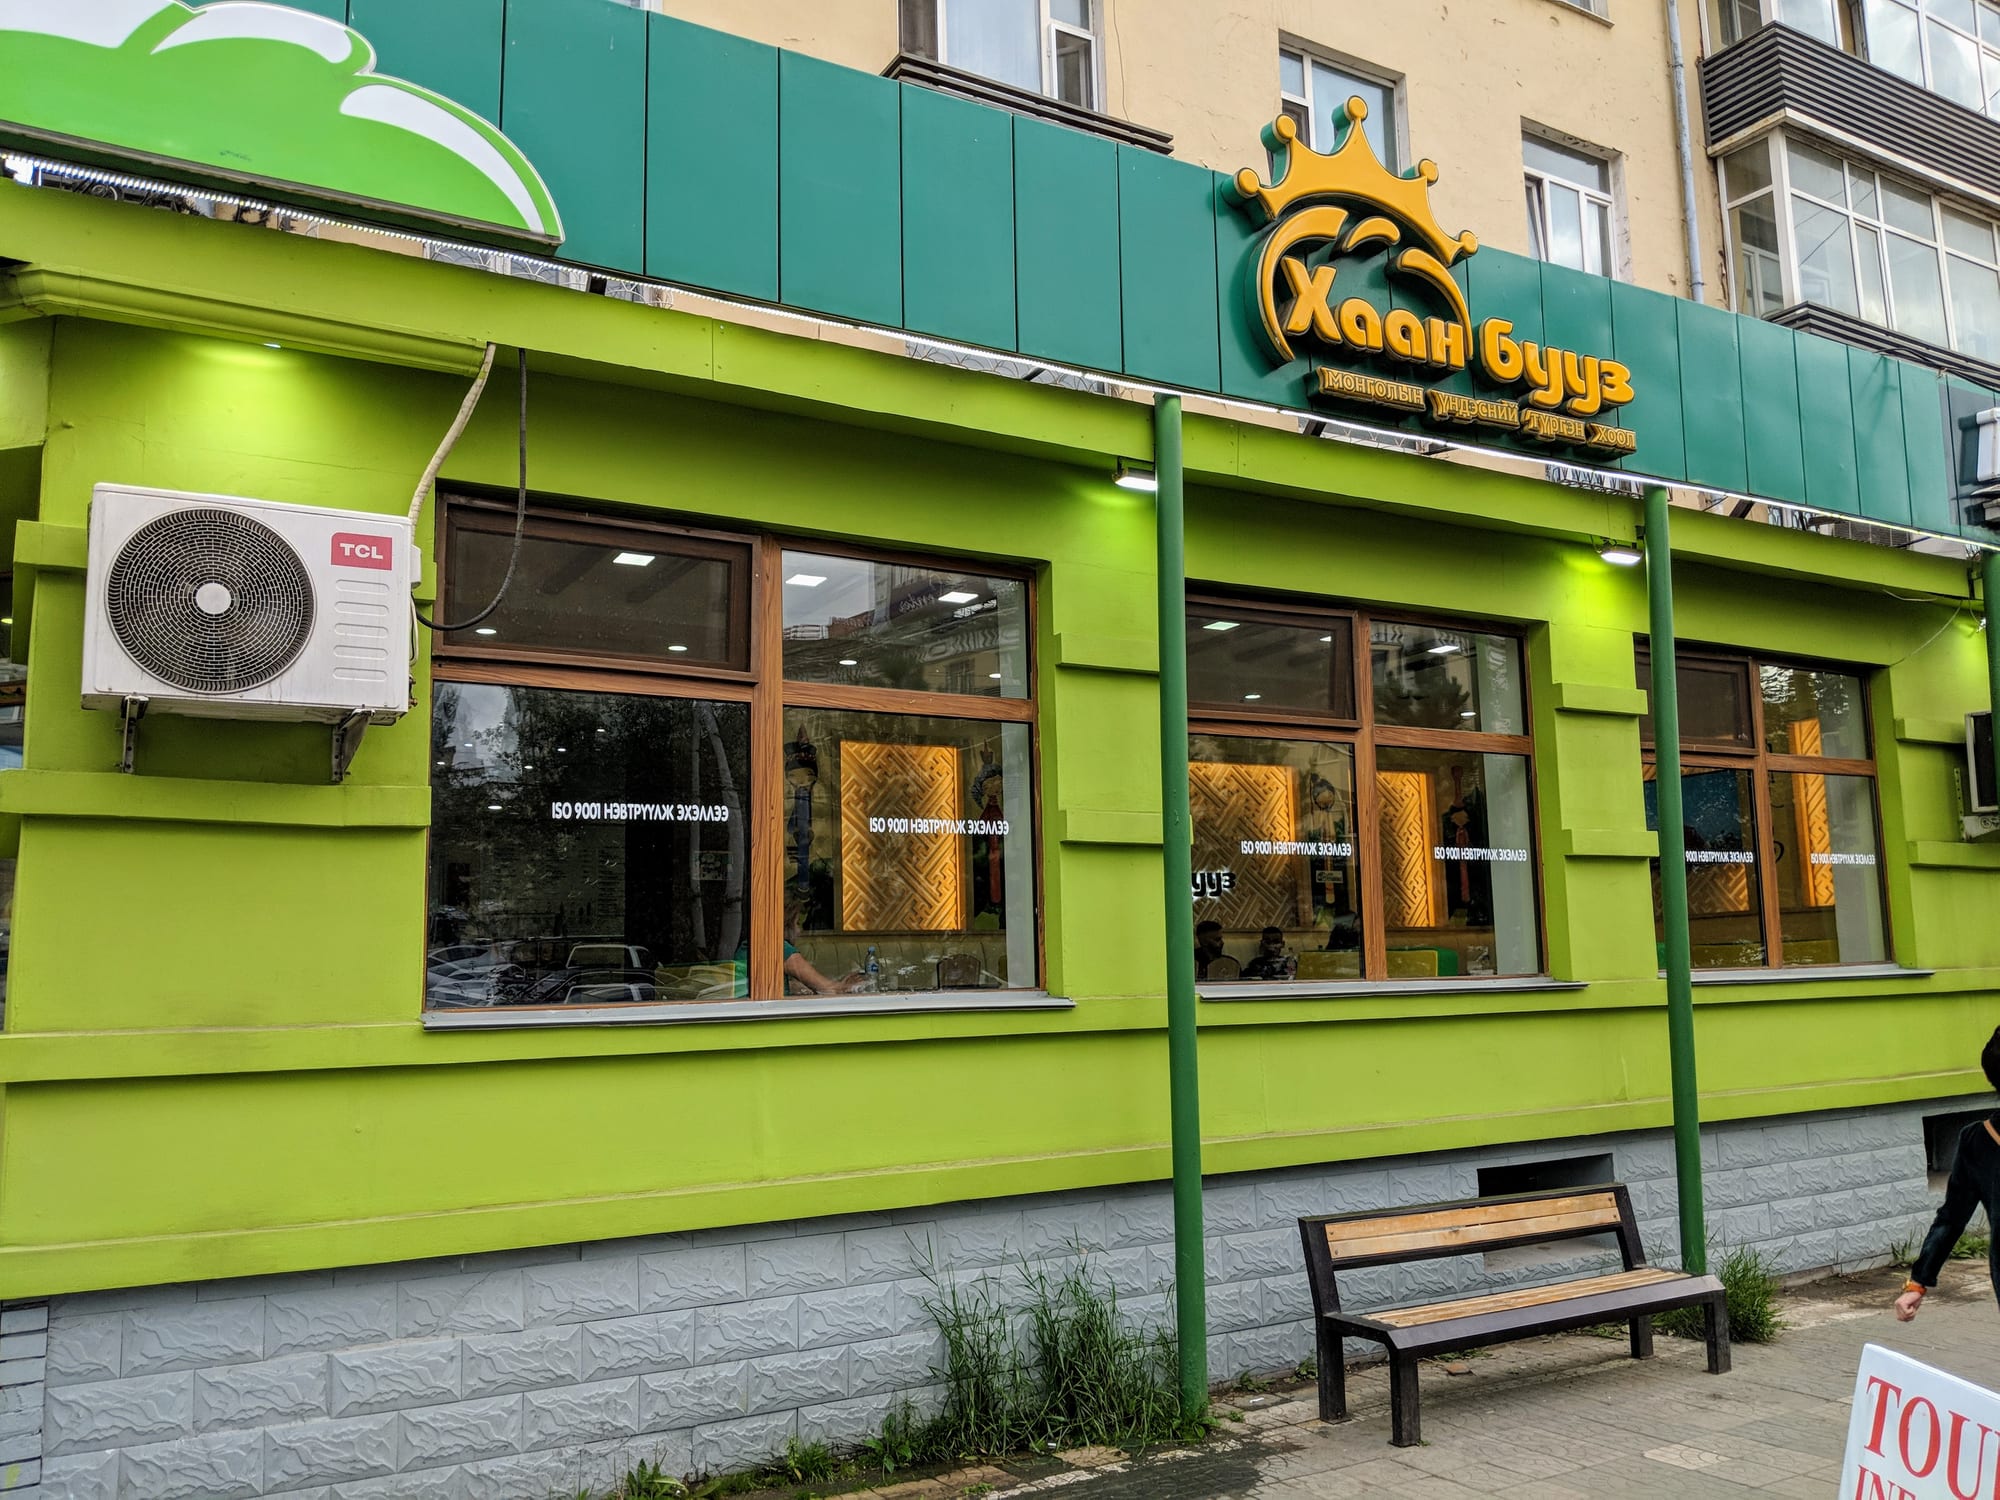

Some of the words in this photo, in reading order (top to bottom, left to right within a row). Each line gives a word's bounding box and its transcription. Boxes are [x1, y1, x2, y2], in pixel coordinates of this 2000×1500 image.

[1281, 256, 1465, 370] Хаан
[1479, 317, 1636, 417] бууз
[1321, 367, 1426, 410] МОНГОЛЫН
[1434, 390, 1520, 427] ҮНДЭСНИЙ
[1527, 409, 1586, 440] ТҮРГЭН
[1593, 424, 1636, 449] ХООЛ
[339, 542, 384, 560] TCL
[551, 801, 573, 819] ISO
[574, 802, 601, 820] 9001
[604, 803, 675, 821] НЭВТРҮҮЛЖ
[676, 804, 729, 822] ЭХЭЛЛЭЭ
[869, 817, 886, 833] ISO
[887, 817, 909, 834] 9001
[910, 818, 966, 835] НЭВТРҮҮЛЖ
[967, 819, 1010, 836] ЭХЭЛЛЭЭ
[1240, 840, 1254, 855] ISO
[1254, 841, 1272, 855] 9001
[1434, 846, 1446, 860] ISO
[1446, 847, 1461, 860] 9001
[1192, 871, 1236, 898] ууз
[1863, 1375, 2000, 1500] TOU
